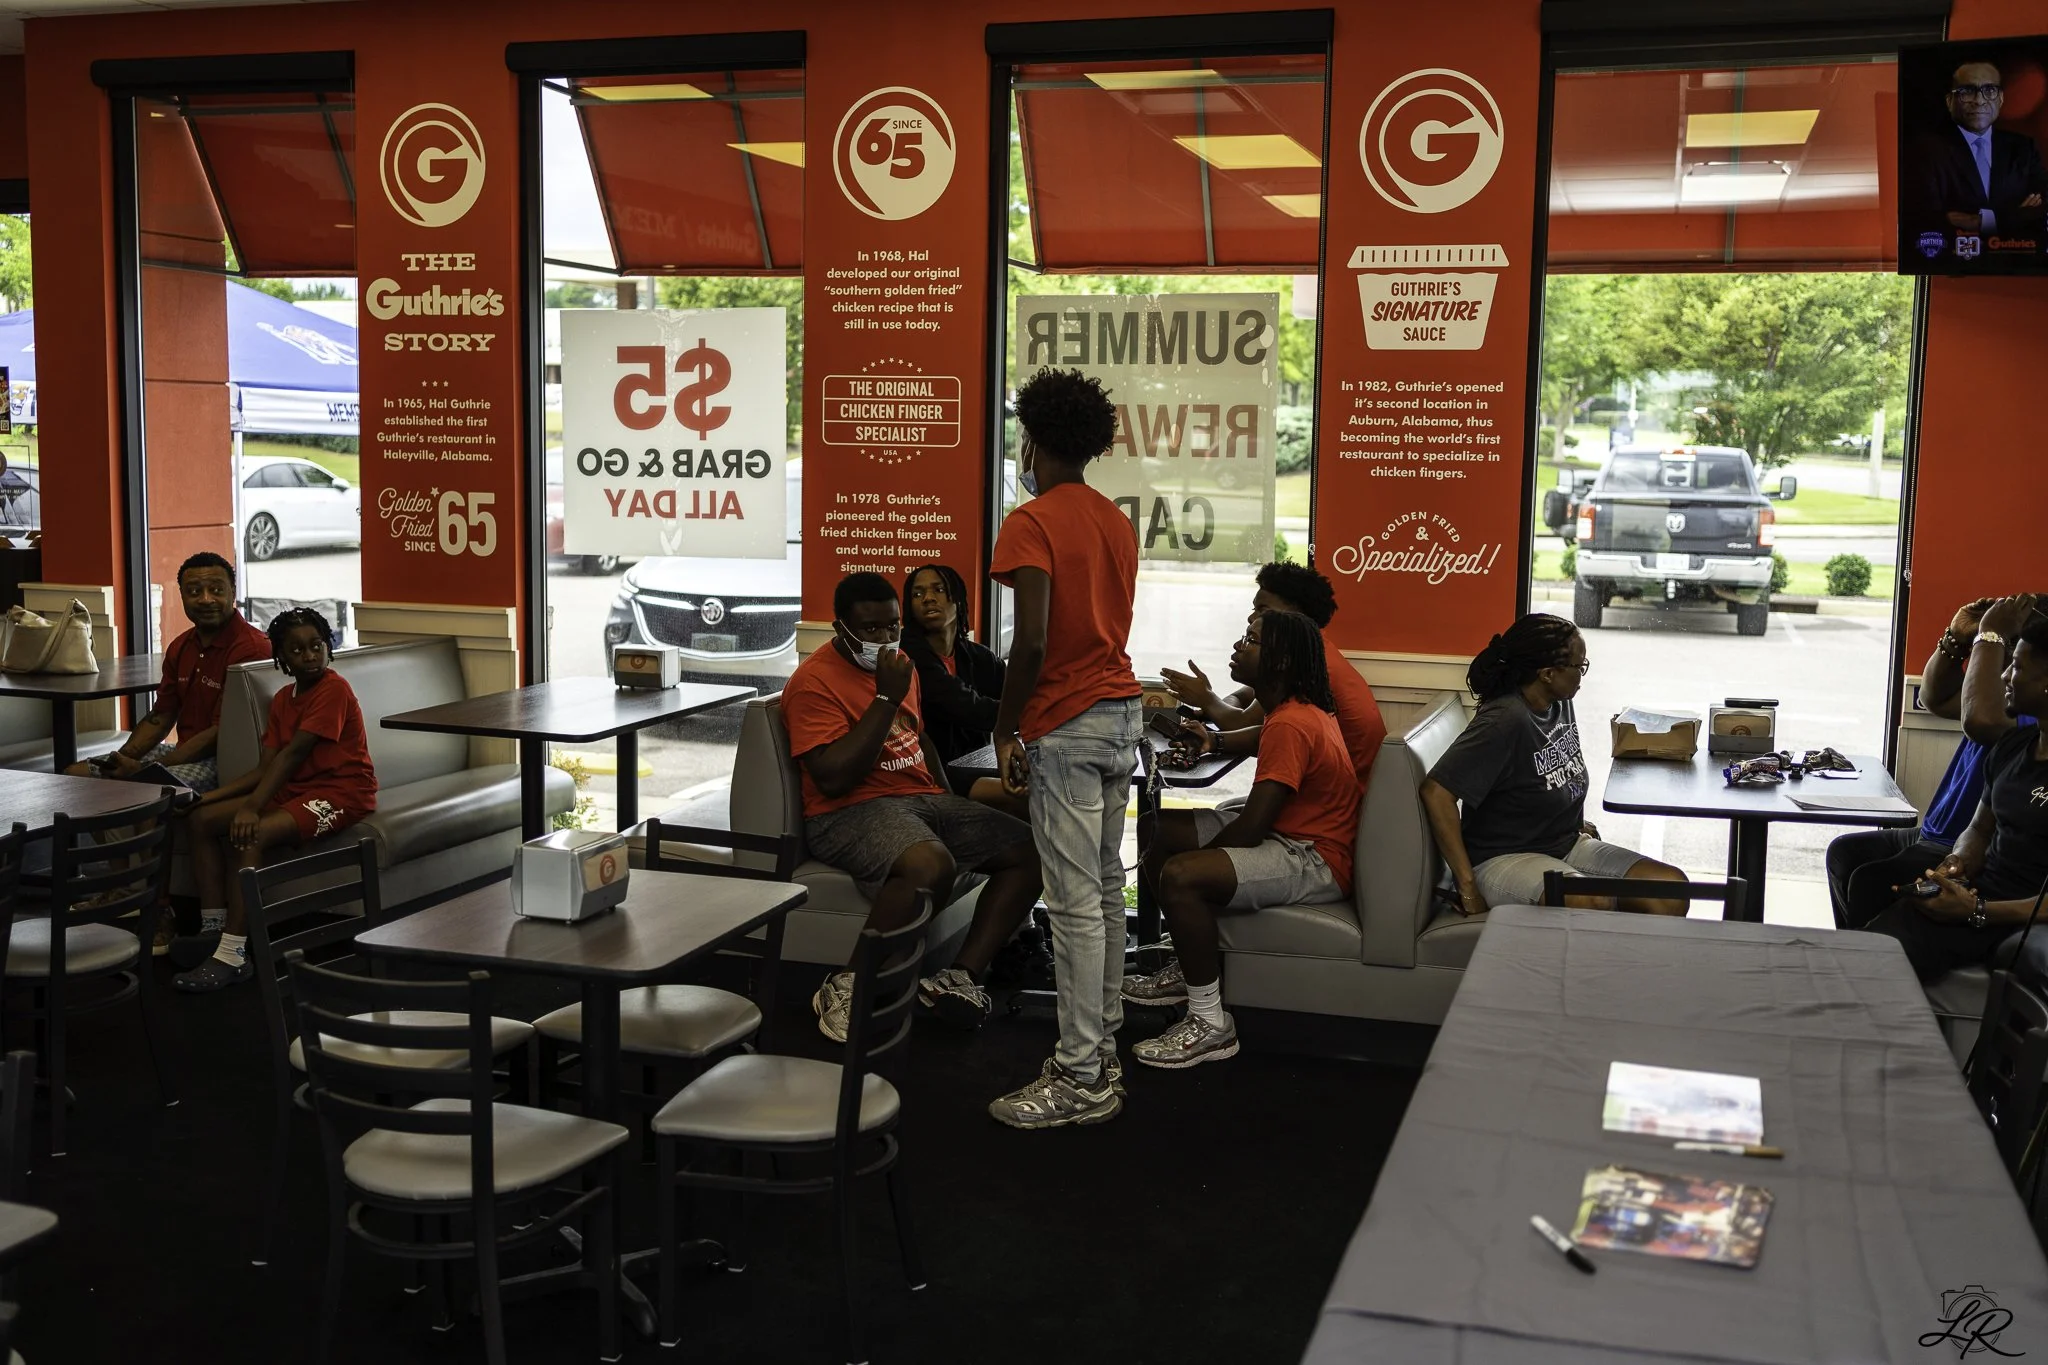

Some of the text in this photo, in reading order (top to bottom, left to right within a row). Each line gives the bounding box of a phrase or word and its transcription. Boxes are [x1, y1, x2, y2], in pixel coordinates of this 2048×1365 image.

[892, 120, 922, 129] SINCE
[856, 118, 925, 179] 65
[402, 253, 475, 271] THE
[858, 250, 928, 262] In 1968, Hal
[827, 268, 887, 280] developed
[914, 267, 959, 280] original
[885, 285, 924, 297] golden
[1391, 281, 1461, 297] GUTHRIE'S
[366, 278, 504, 320] Guthrie's
[833, 302, 953, 314] chicken recipe that is
[1371, 300, 1482, 322] SIGNATURE
[844, 319, 864, 329] still
[868, 319, 878, 329] in
[905, 319, 940, 331] today.
[1403, 327, 1446, 341] SAUCE
[385, 333, 495, 351] STORY
[849, 381, 934, 397] THE ORIGINAL
[1342, 381, 1503, 394] In 1982, Guthrie's opened
[384, 398, 490, 409] In 1965, Hal Guthrie
[1355, 398, 1488, 409] it's second location in
[840, 404, 942, 419] CHICKEN FINGER
[385, 415, 487, 426] established the first
[1349, 415, 1493, 428] Auburn, Alabama, thus
[377, 432, 495, 444] Guthrie's restaurant in
[855, 426, 926, 442] SPECIALIST
[1341, 432, 1500, 445] becoming the world's first
[384, 450, 492, 462] Haleyville, Alabama.
[1340, 450, 1500, 463] restaurant to specialize in
[1371, 466, 1466, 480] chicken fingers.
[378, 488, 433, 519] Golden
[837, 493, 940, 505] In 1978 Guthrie's
[438, 490, 497, 557] 65
[826, 510, 951, 524] pioneered the golden
[391, 515, 434, 538] Fried
[1381, 511, 1461, 543] GOLDEN FRIED
[820, 527, 956, 541] fried chicken finger box
[1416, 527, 1429, 540] &
[405, 541, 435, 552] SINCE
[836, 545, 940, 557] and world famous
[1332, 535, 1502, 585] Specialized!
[840, 562, 896, 574] signature
